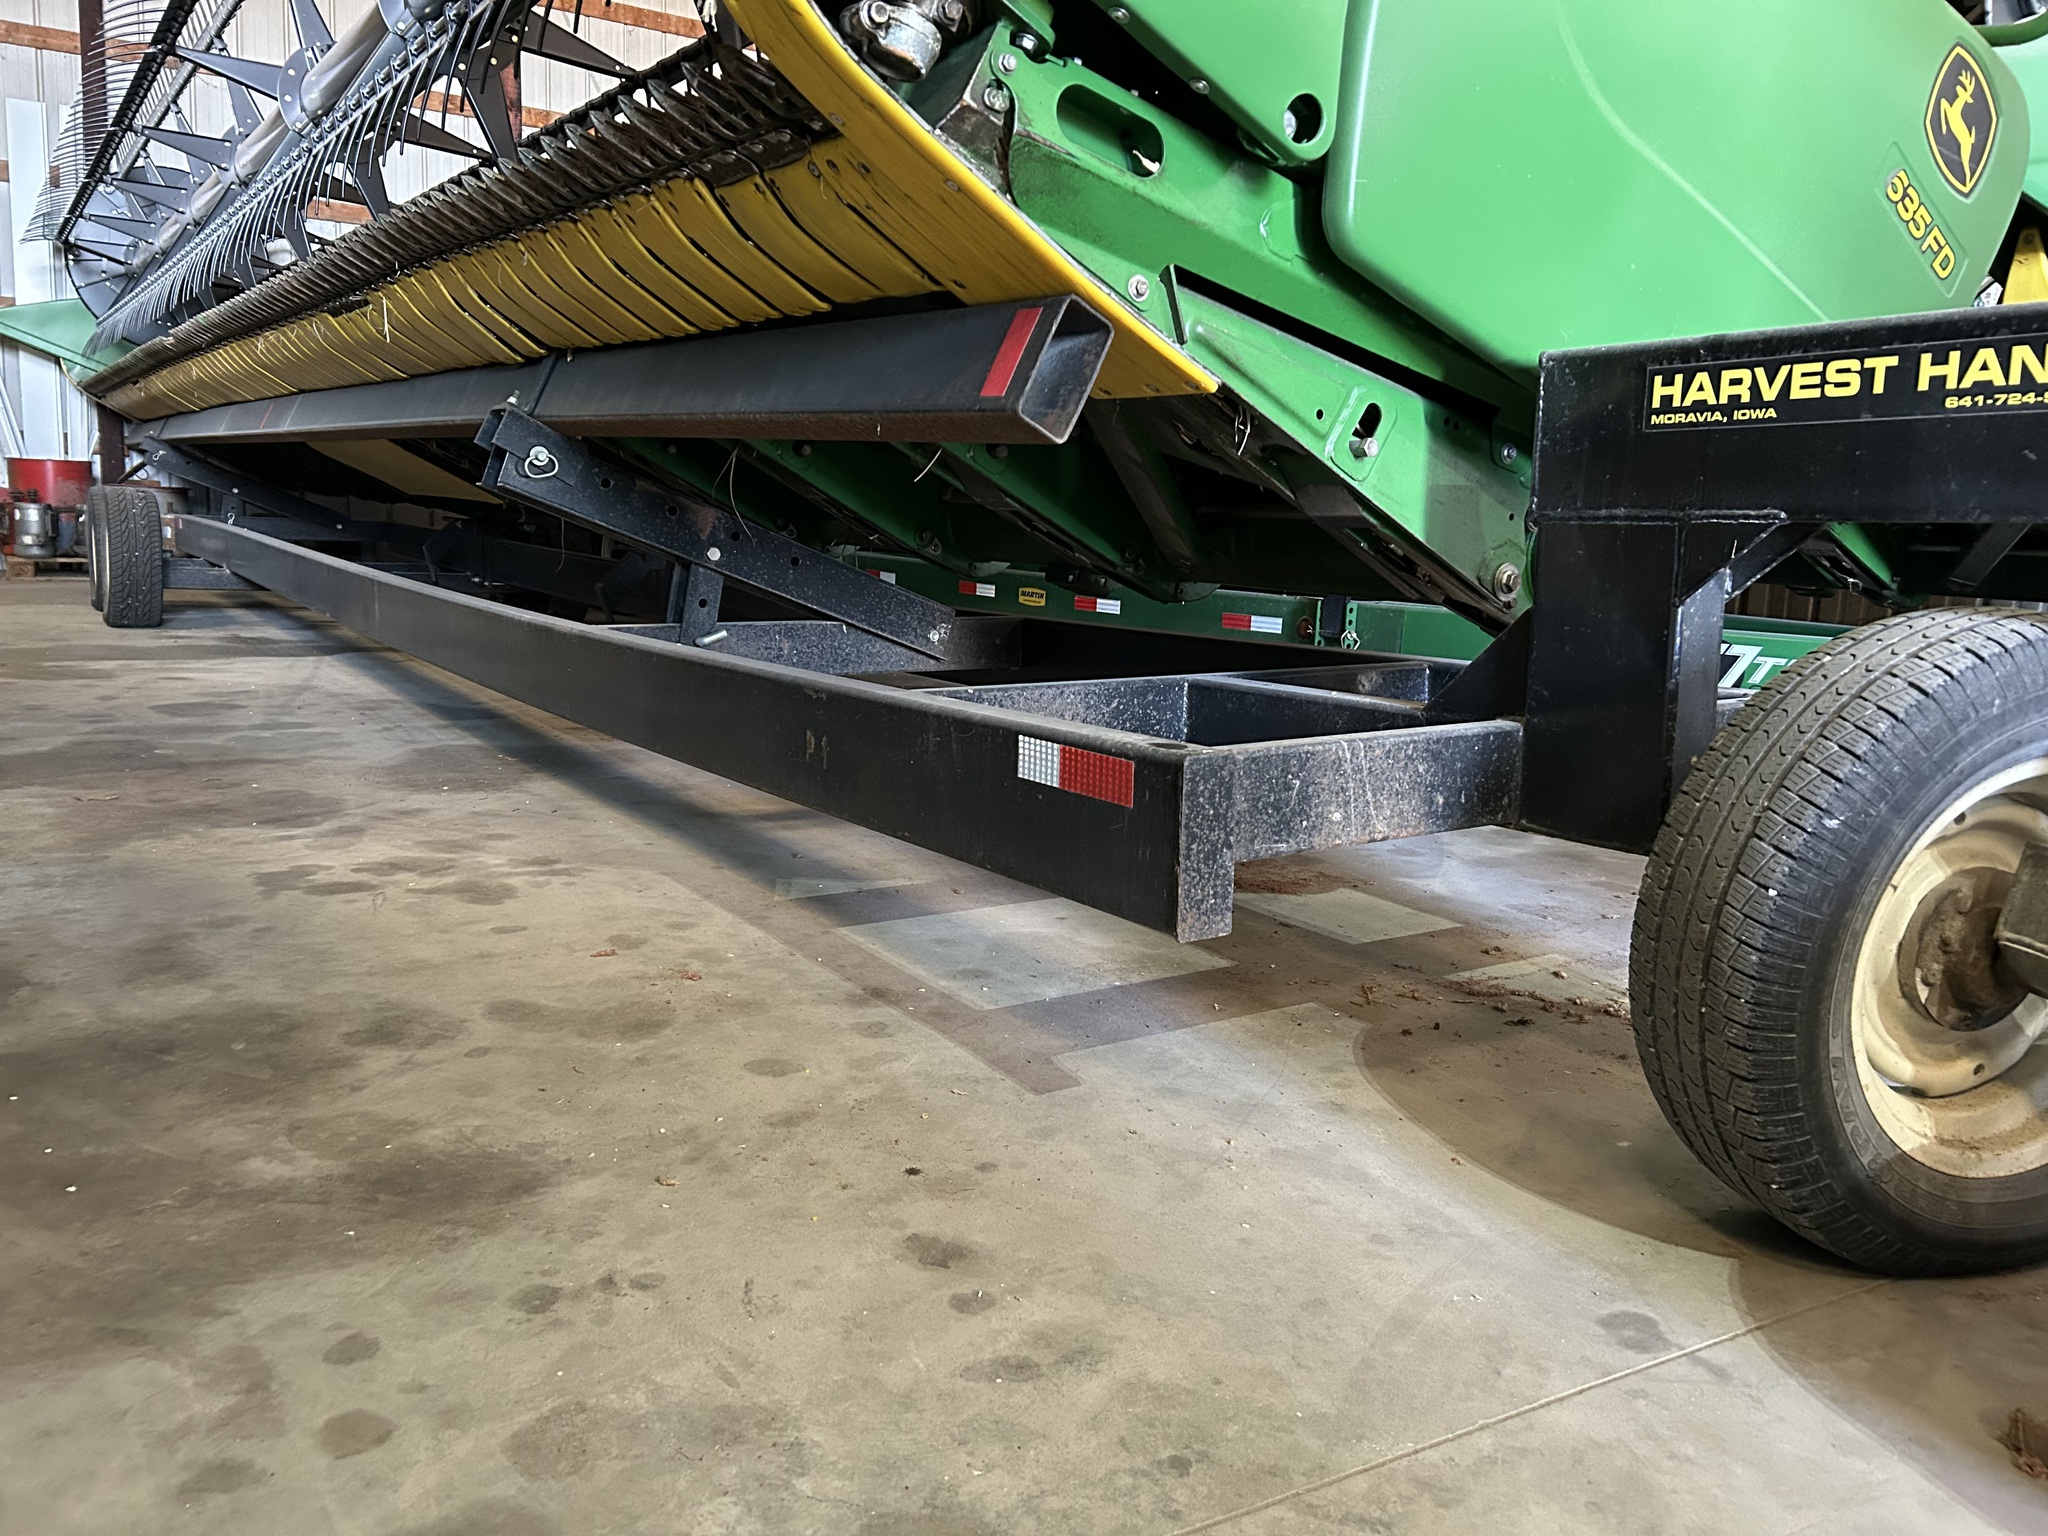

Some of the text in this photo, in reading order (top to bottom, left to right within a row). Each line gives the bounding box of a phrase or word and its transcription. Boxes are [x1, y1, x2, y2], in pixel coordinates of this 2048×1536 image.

[1651, 344, 2048, 409] HARVEST HAN
[1650, 407, 1778, 425] MORAVIA, IOWA
[1021, 590, 1045, 599] MARTIN
